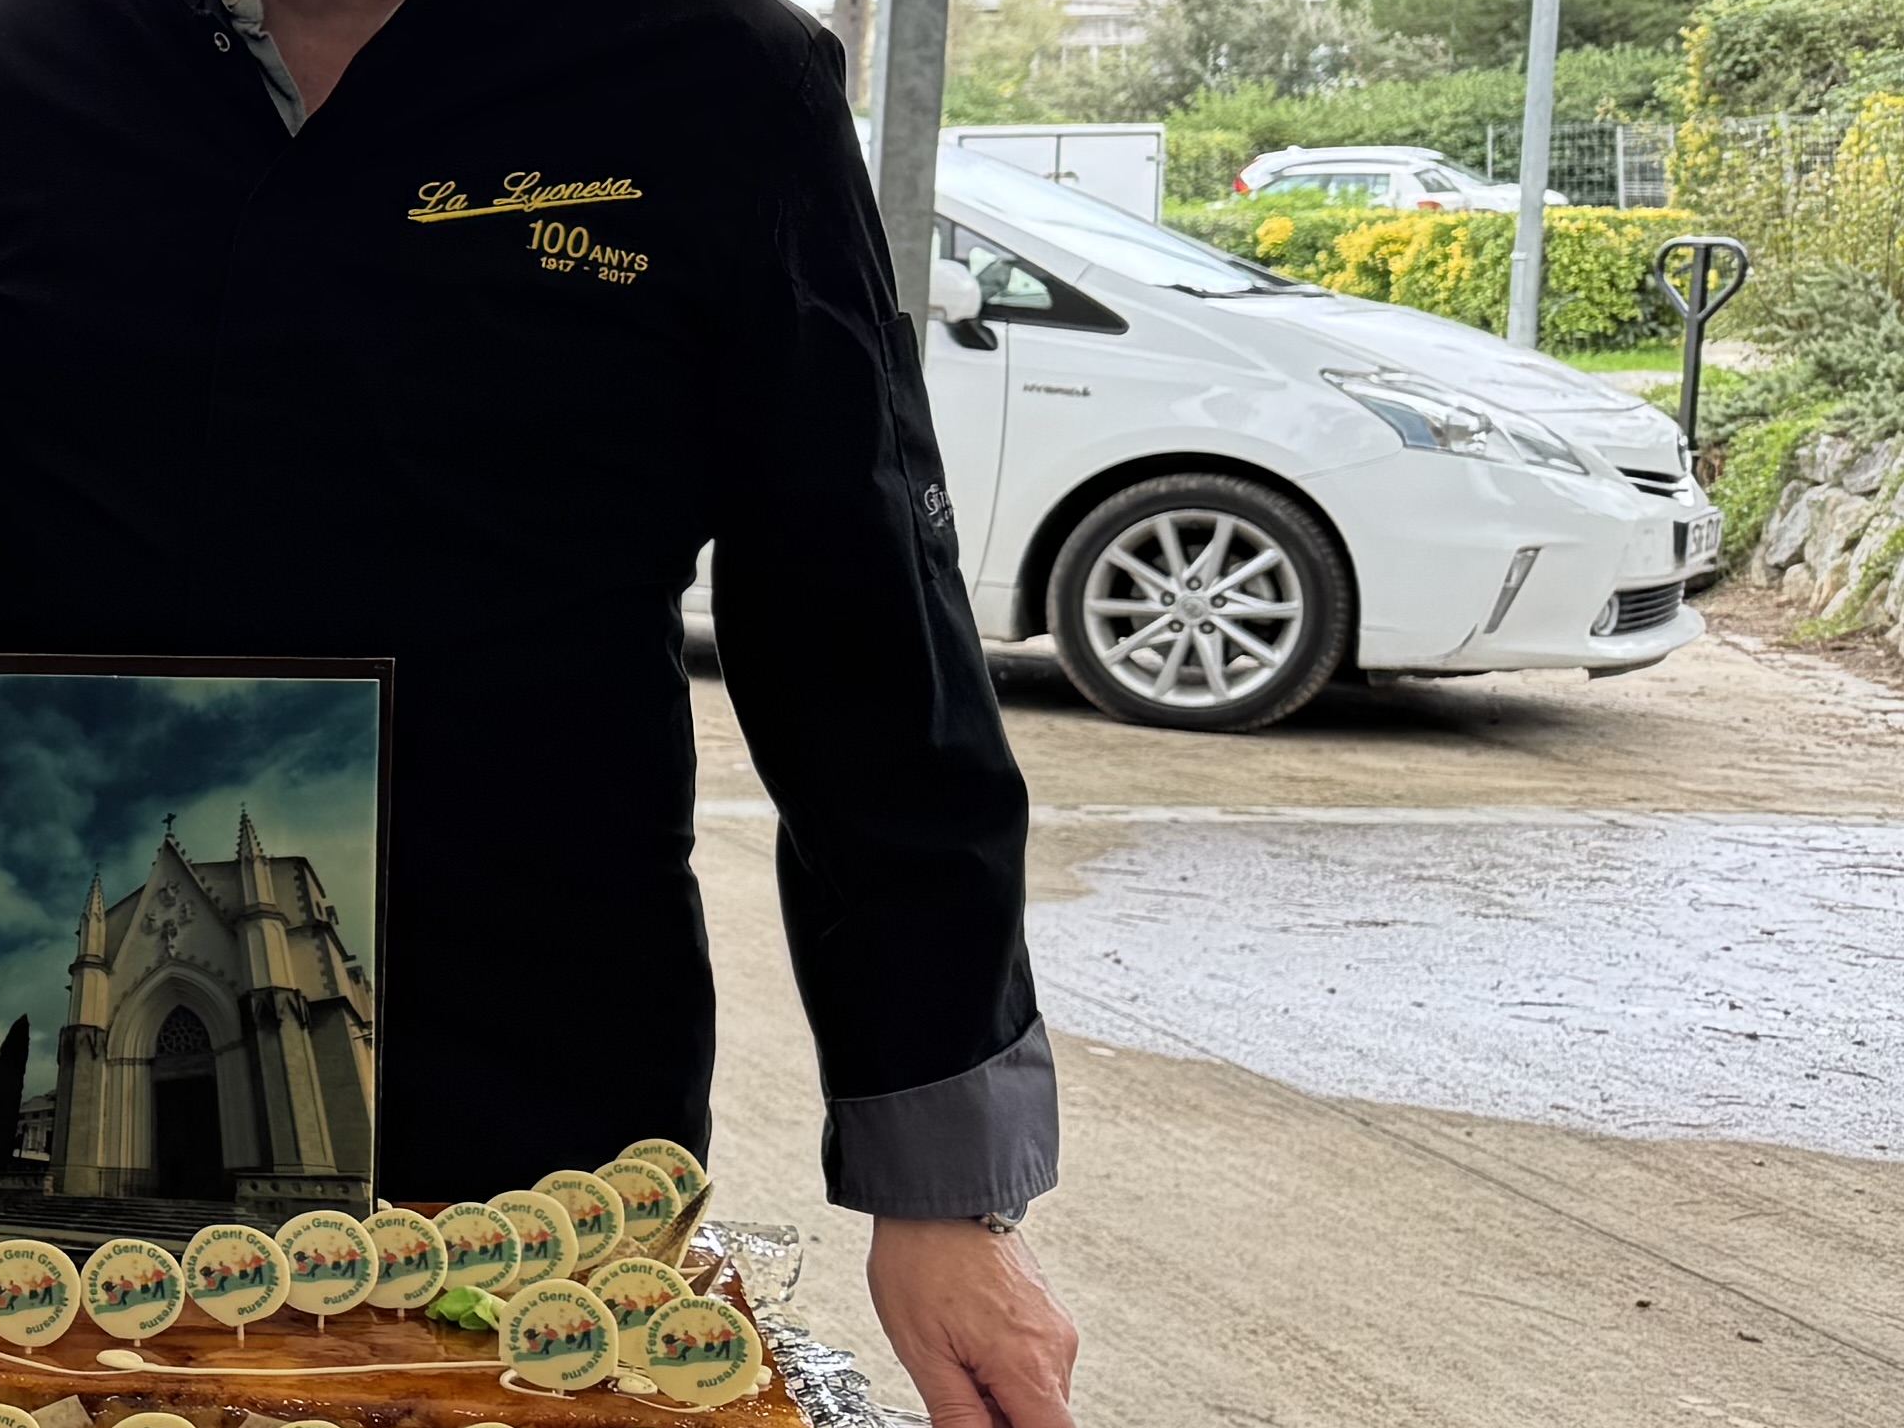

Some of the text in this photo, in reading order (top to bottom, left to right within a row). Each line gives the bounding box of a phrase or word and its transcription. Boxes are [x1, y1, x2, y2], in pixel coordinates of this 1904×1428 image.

[407, 170, 643, 215] La Lyonesa
[525, 219, 649, 272] 100 ANYS
[539, 256, 576, 274] 1917
[597, 267, 637, 285] 2017
[537, 1291, 572, 1303] Gent
[575, 1296, 602, 1323] Gran
[508, 1316, 522, 1352] Festa
[560, 1342, 609, 1381] Maresme
